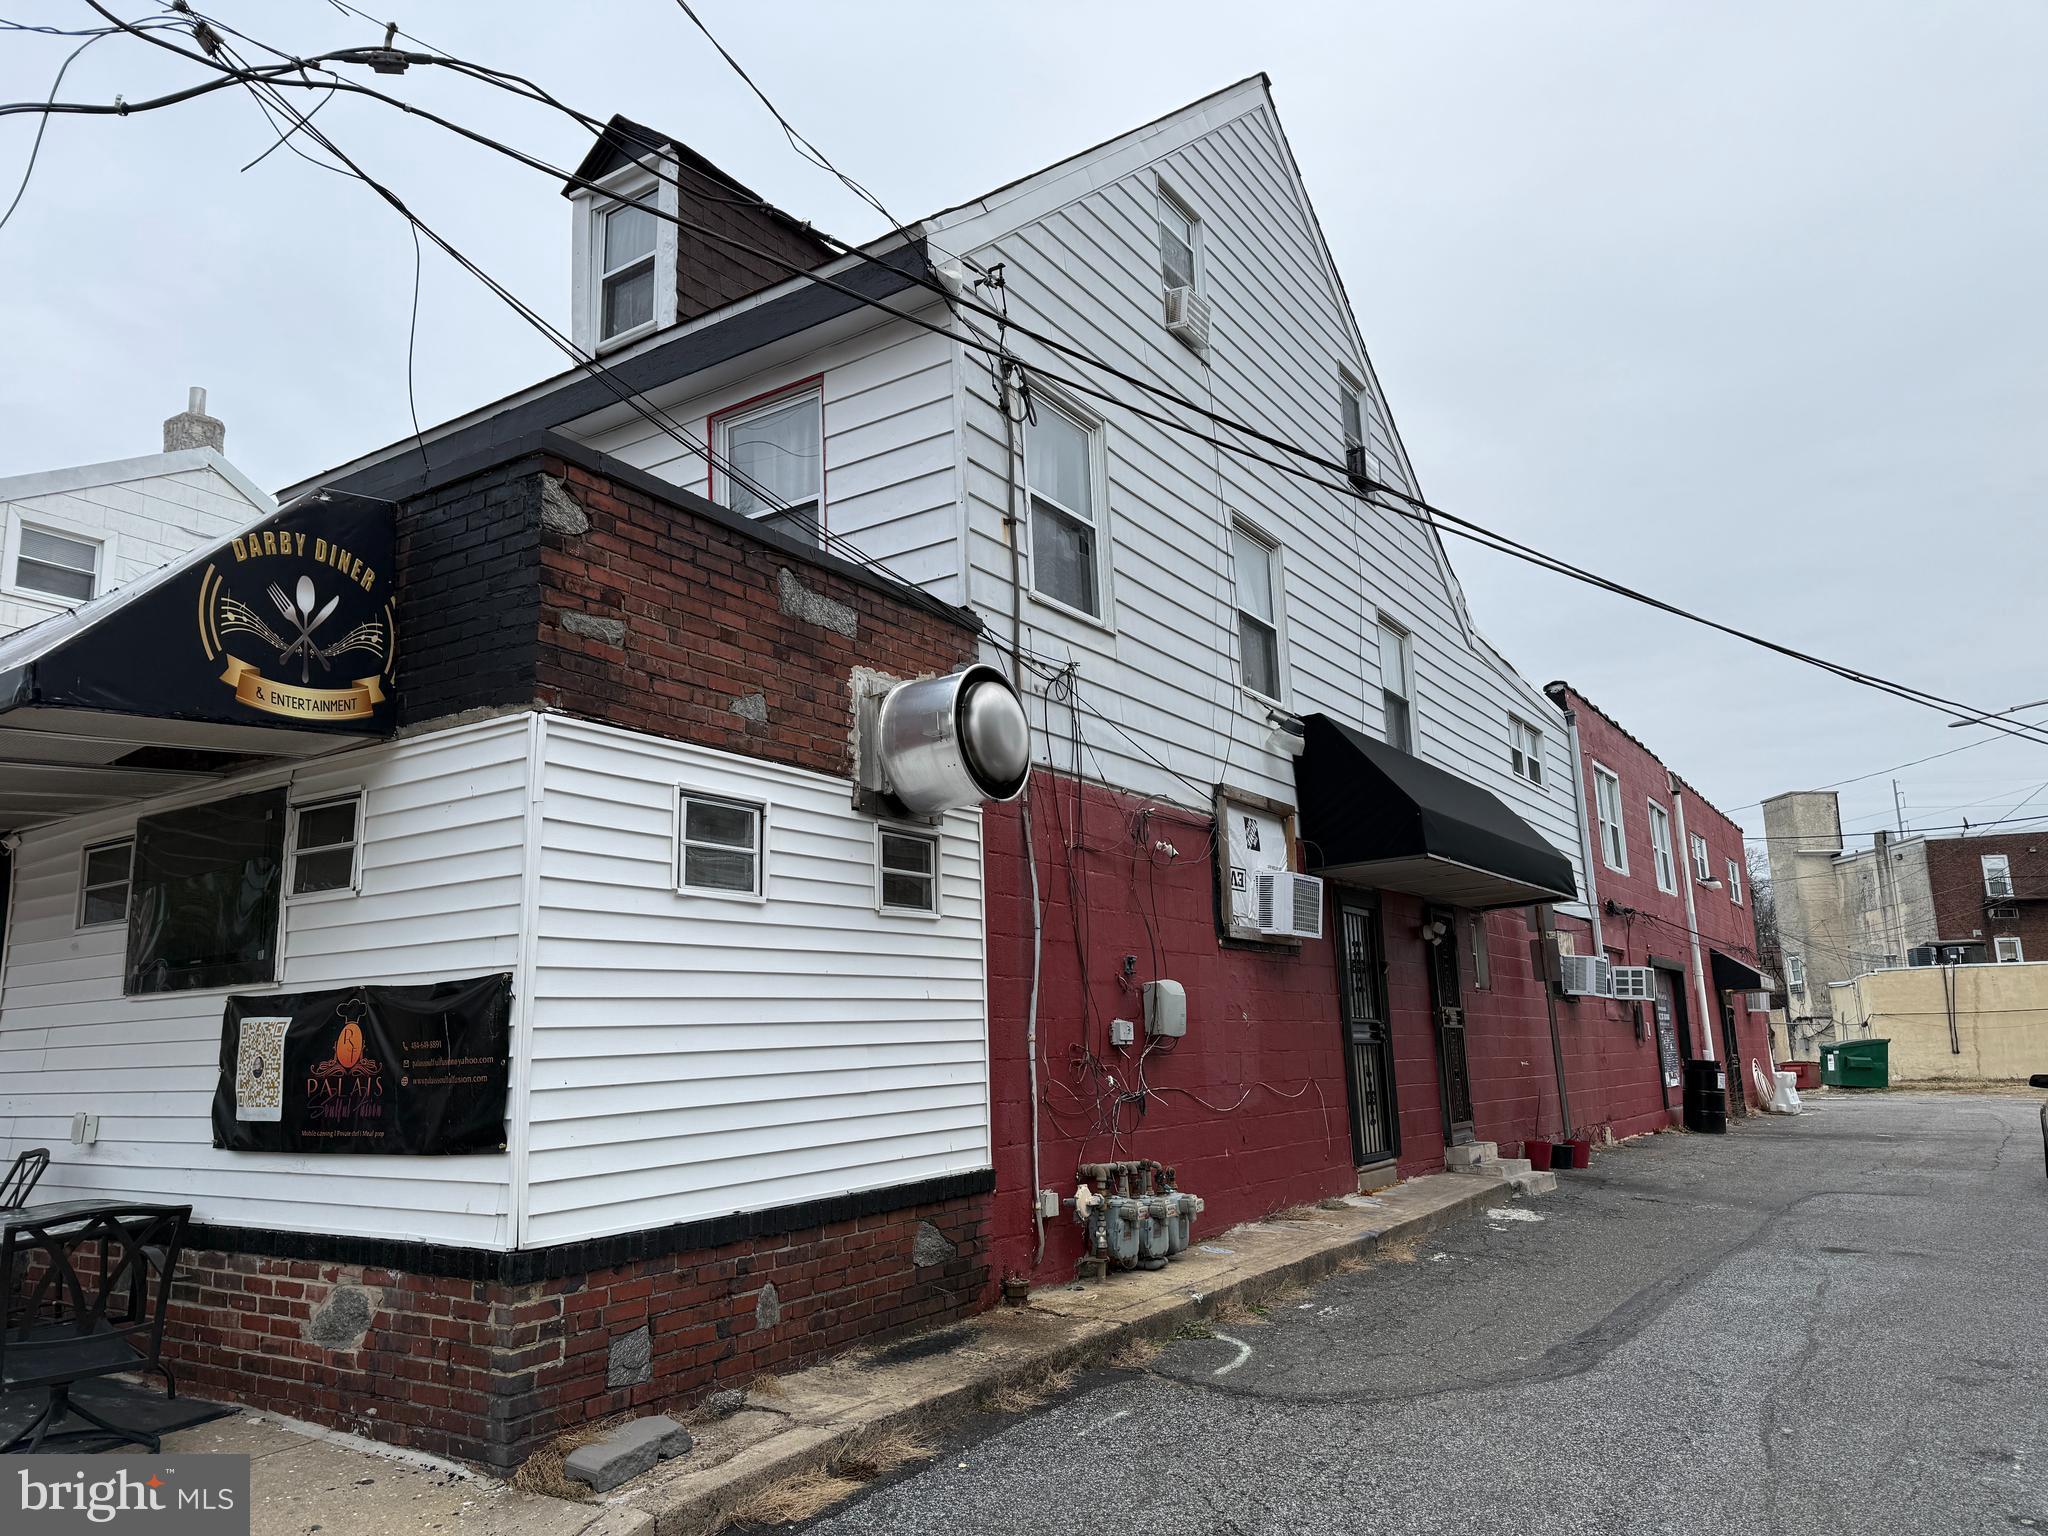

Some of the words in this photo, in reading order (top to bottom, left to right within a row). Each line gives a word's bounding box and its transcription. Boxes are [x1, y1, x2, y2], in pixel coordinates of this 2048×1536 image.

[231, 531, 306, 562] DARBY
[315, 538, 376, 593] DINER
[256, 686, 265, 701] &
[271, 691, 358, 712] ENTERTAINMENT
[307, 1076, 383, 1098] PALAIS
[304, 1088, 352, 1122] Soulful
